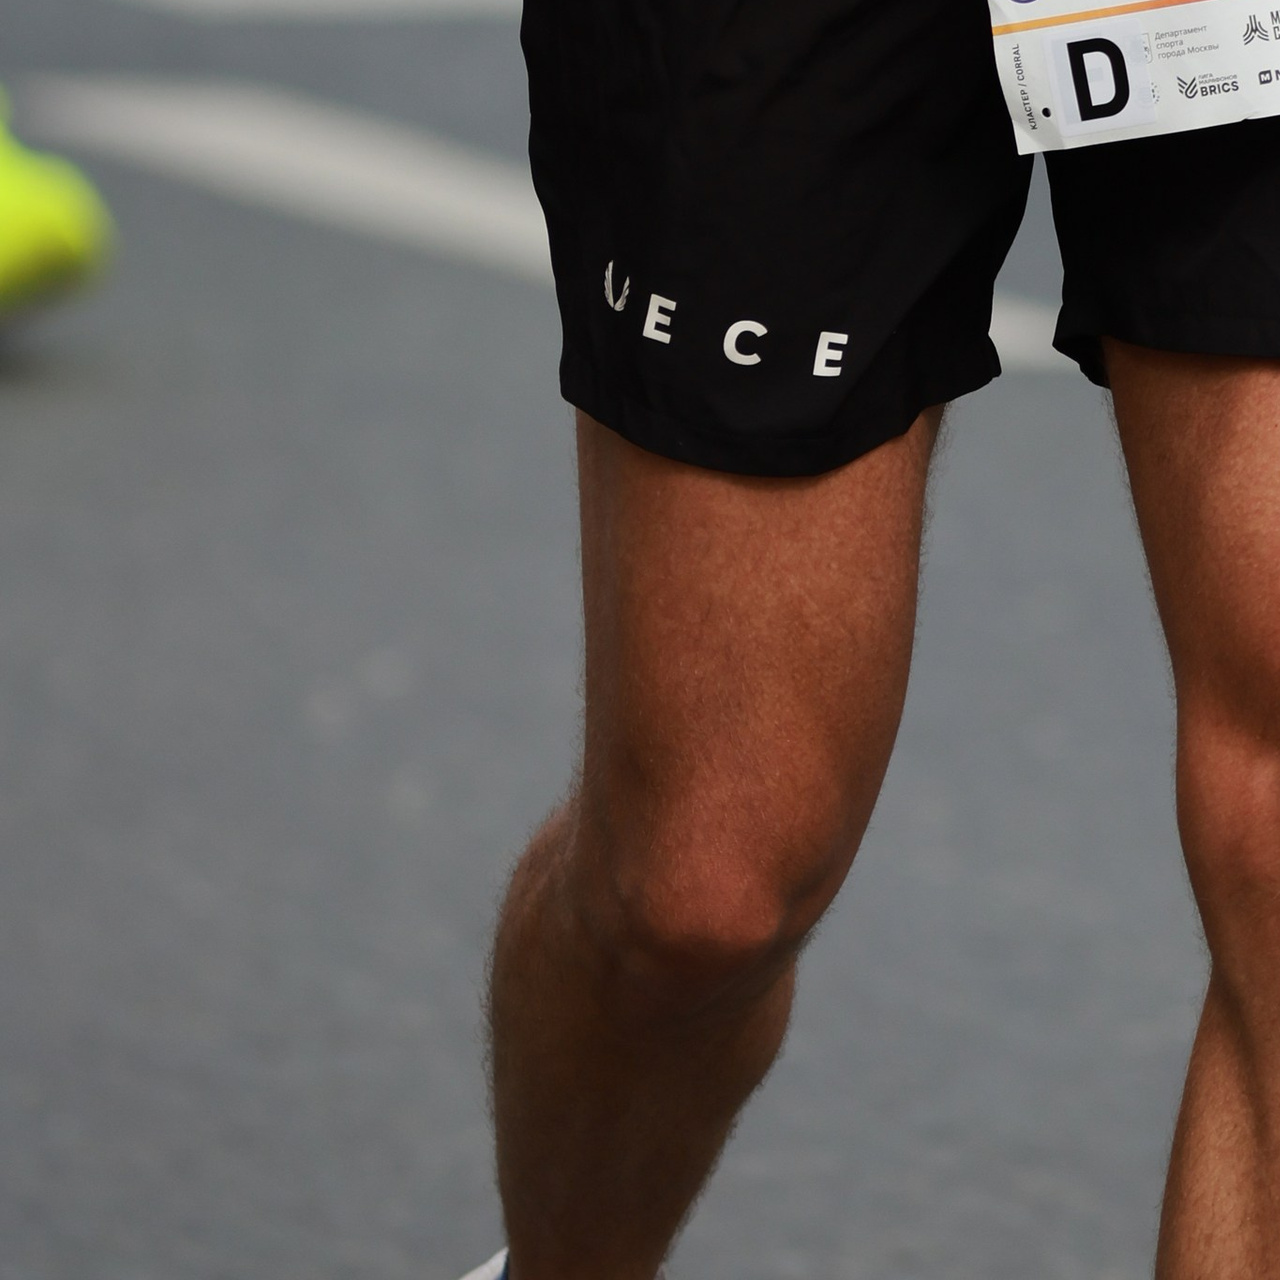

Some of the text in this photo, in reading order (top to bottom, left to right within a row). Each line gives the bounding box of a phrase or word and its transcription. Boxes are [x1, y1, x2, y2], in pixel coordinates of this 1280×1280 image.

[1155, 25, 1207, 41] Департамент
[1156, 39, 1183, 50] спорта
[1158, 44, 1219, 60] города Москвы
[1012, 44, 1025, 81] CORRAL
[1067, 37, 1130, 122] D
[1200, 81, 1239, 97] BRICS
[1020, 90, 1037, 130] КЛАСТЕР
